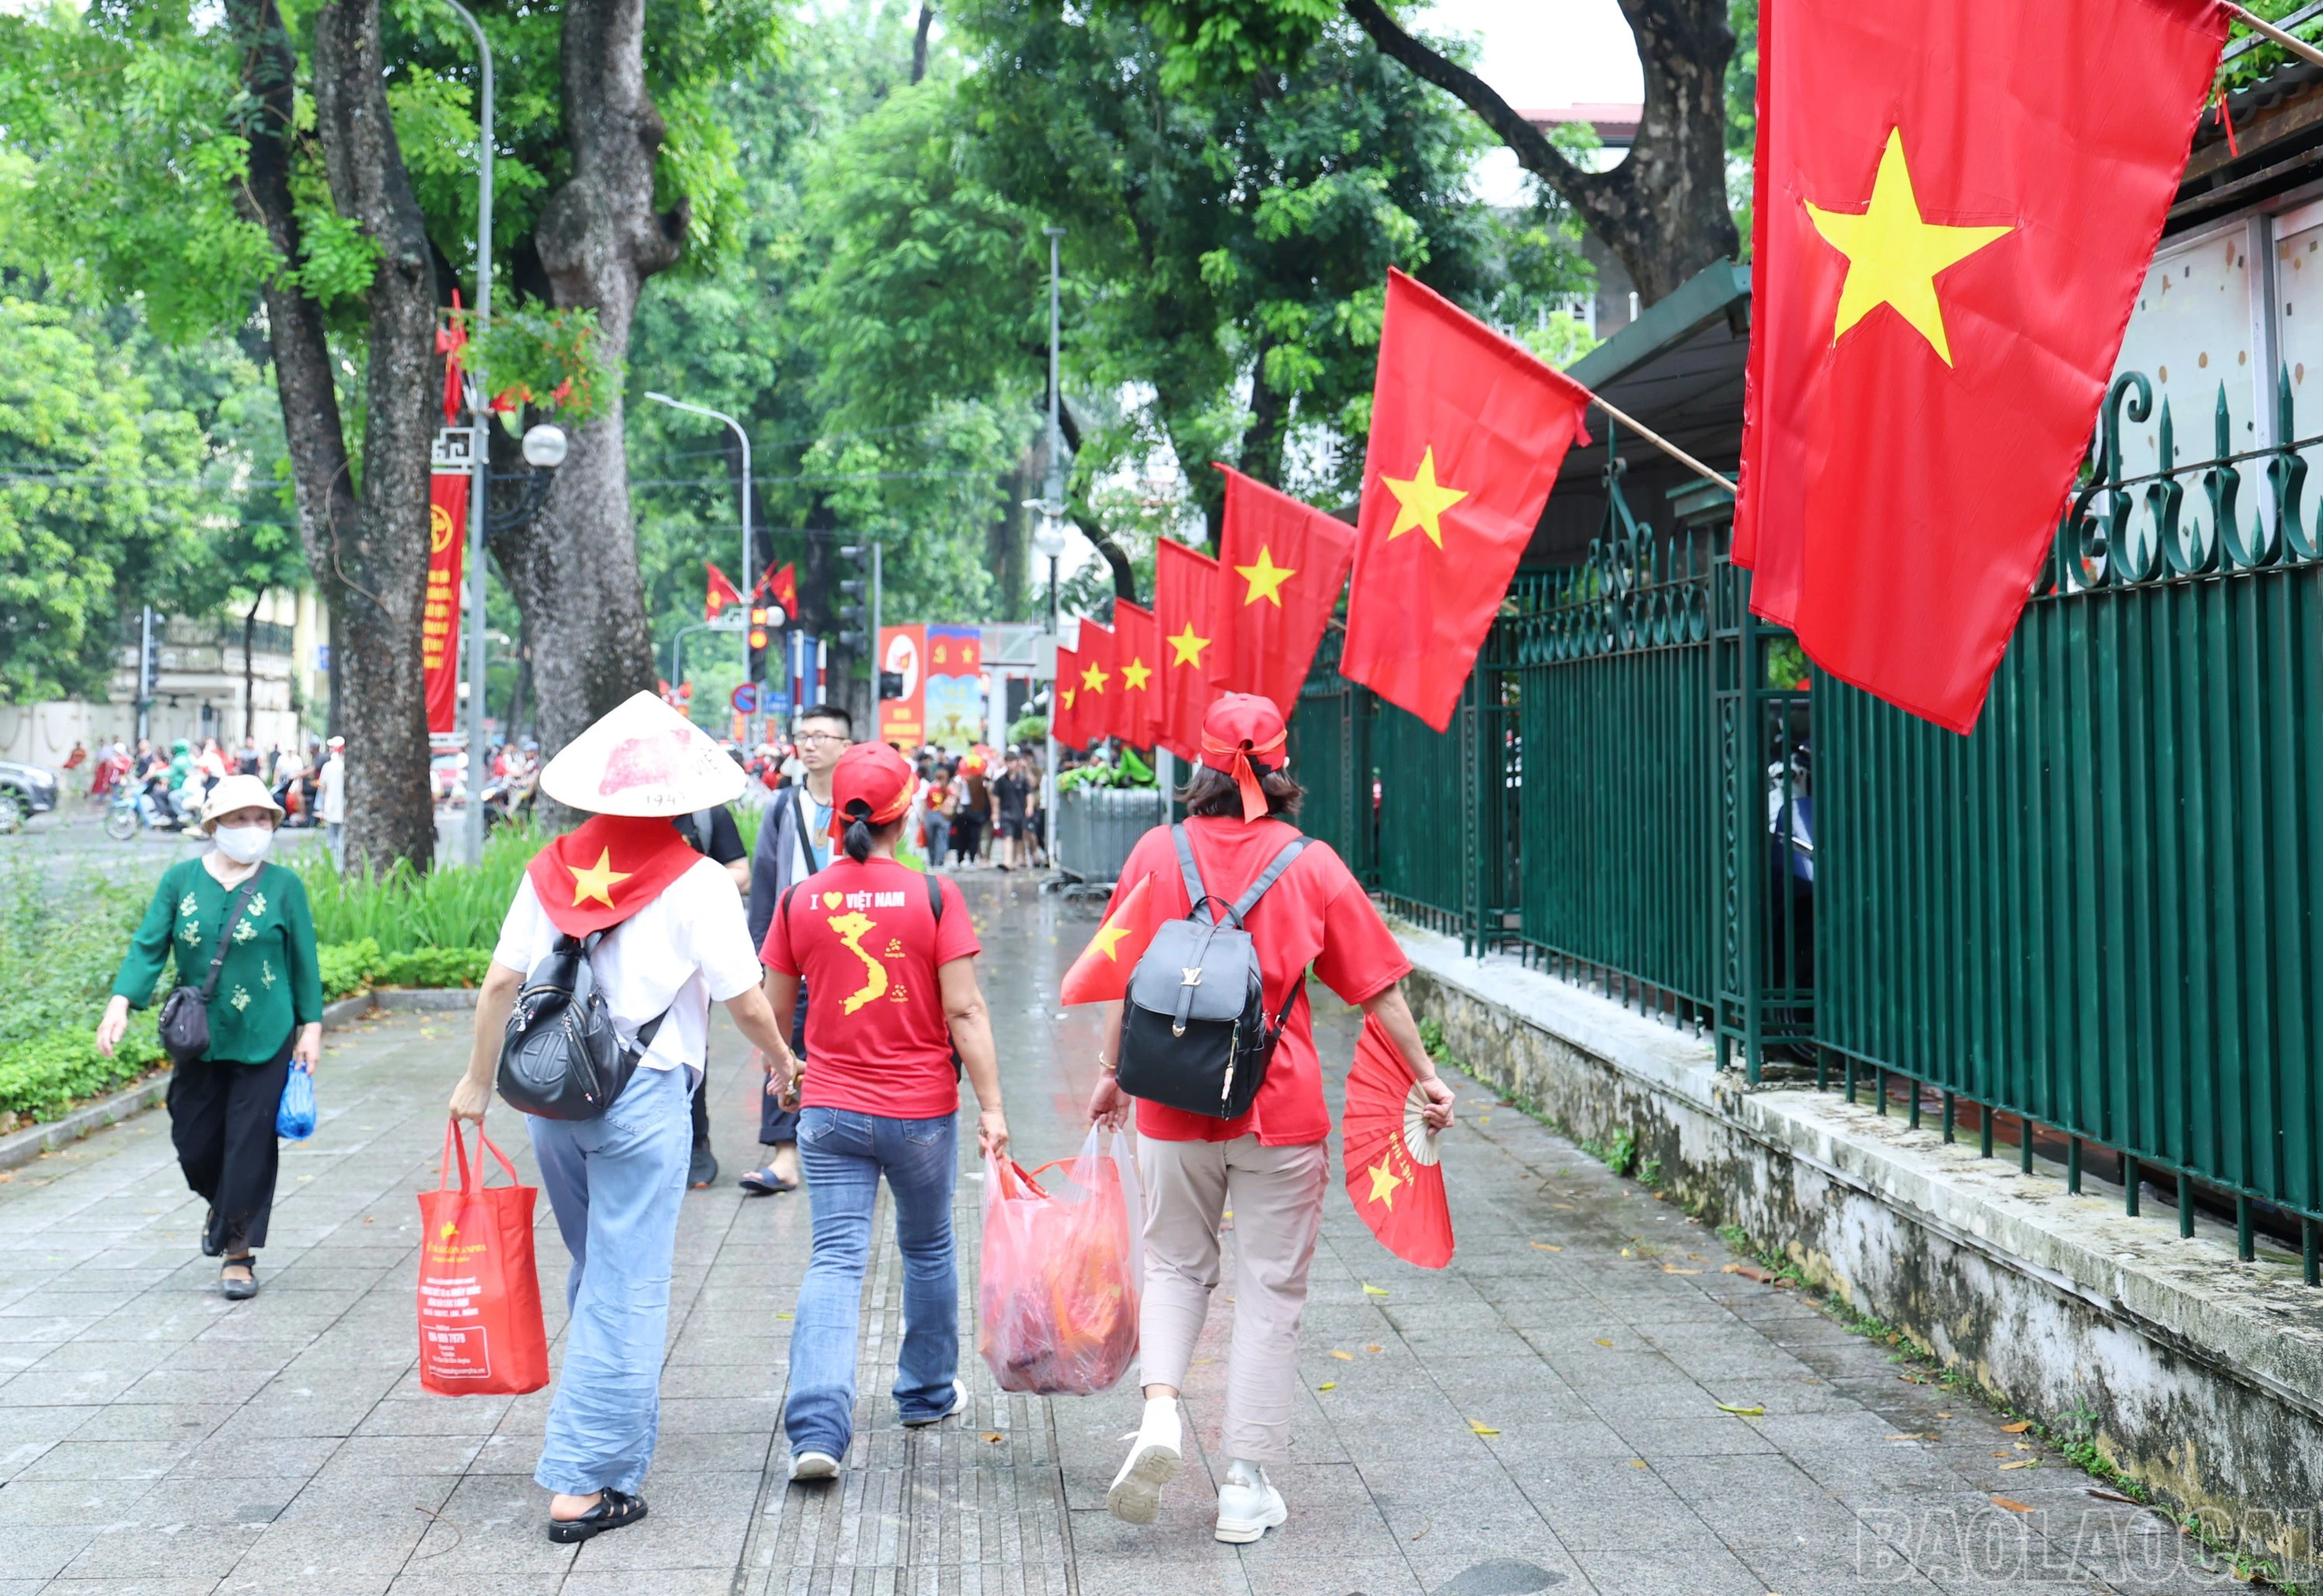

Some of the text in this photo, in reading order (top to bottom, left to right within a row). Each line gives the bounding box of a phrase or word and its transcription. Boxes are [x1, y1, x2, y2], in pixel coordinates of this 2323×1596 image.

[810, 890, 905, 911] I VIỆT NAM
